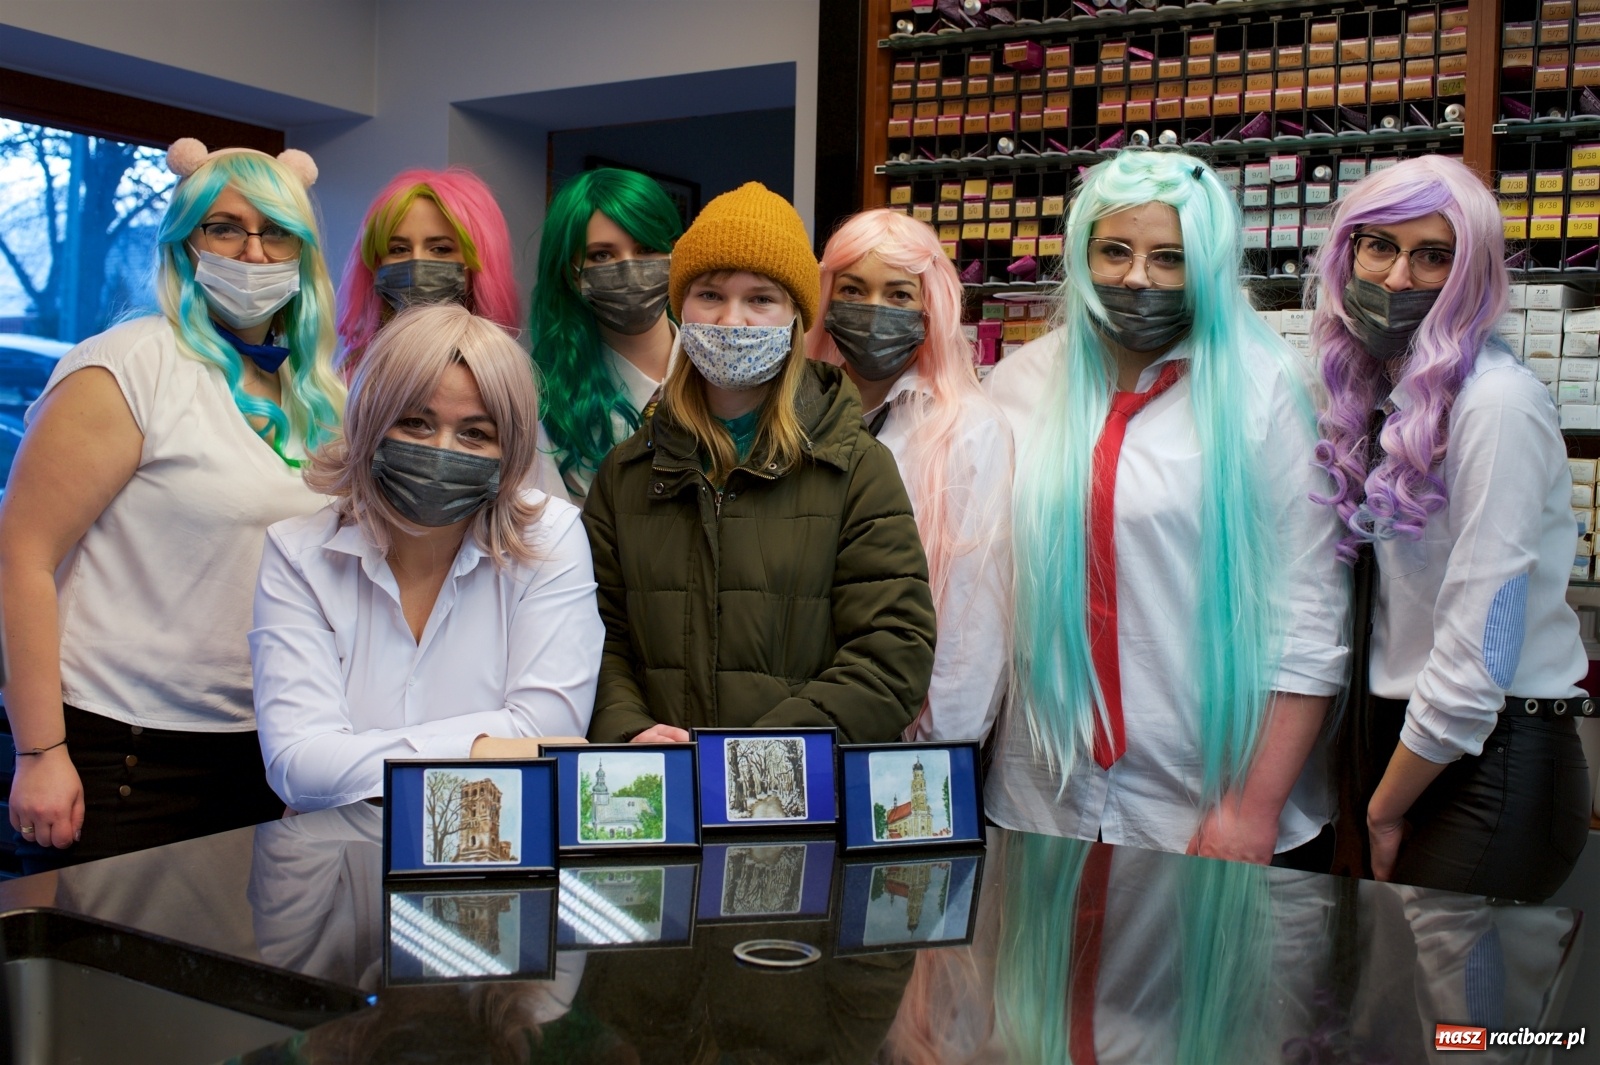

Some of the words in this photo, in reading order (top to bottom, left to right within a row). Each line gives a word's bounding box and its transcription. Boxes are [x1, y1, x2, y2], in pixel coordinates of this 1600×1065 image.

[1549, 7, 1566, 15] 5/73
[1314, 51, 1328, 59] 4/77
[1546, 54, 1562, 62] 5/73
[1544, 74, 1560, 82] 5/73
[1443, 81, 1460, 90] 5/74
[1314, 92, 1328, 100] 4/77
[1344, 90, 1358, 98] 5/77
